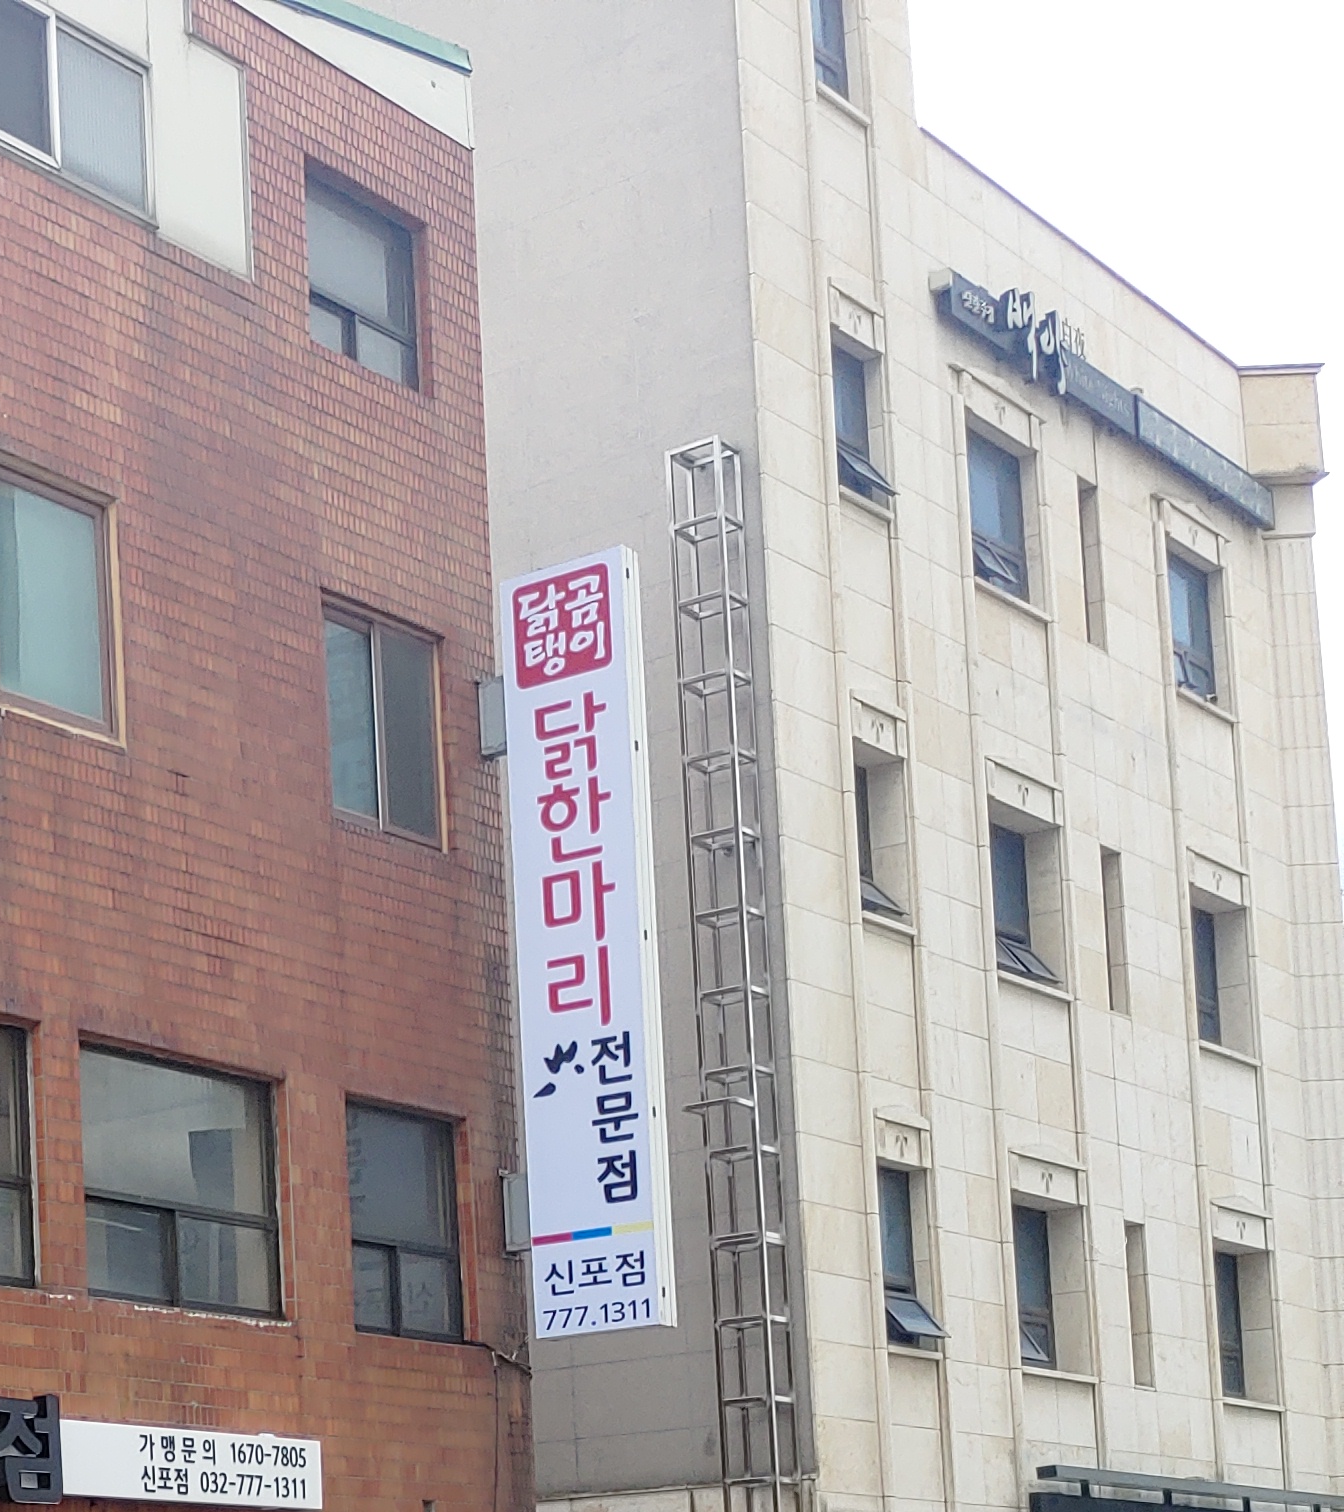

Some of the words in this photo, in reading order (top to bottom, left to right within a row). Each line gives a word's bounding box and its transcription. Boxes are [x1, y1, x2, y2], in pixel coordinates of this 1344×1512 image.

[532, 689, 617, 1028] 닭한마리
[588, 1028, 641, 1204] 전문점
[543, 1248, 648, 1299] 신포점
[542, 1297, 654, 1333] 777.1311
[229, 1441, 308, 1469] 1670-7805
[141, 1464, 190, 1497] 신포점
[199, 1470, 307, 1500] 032-777-1311
